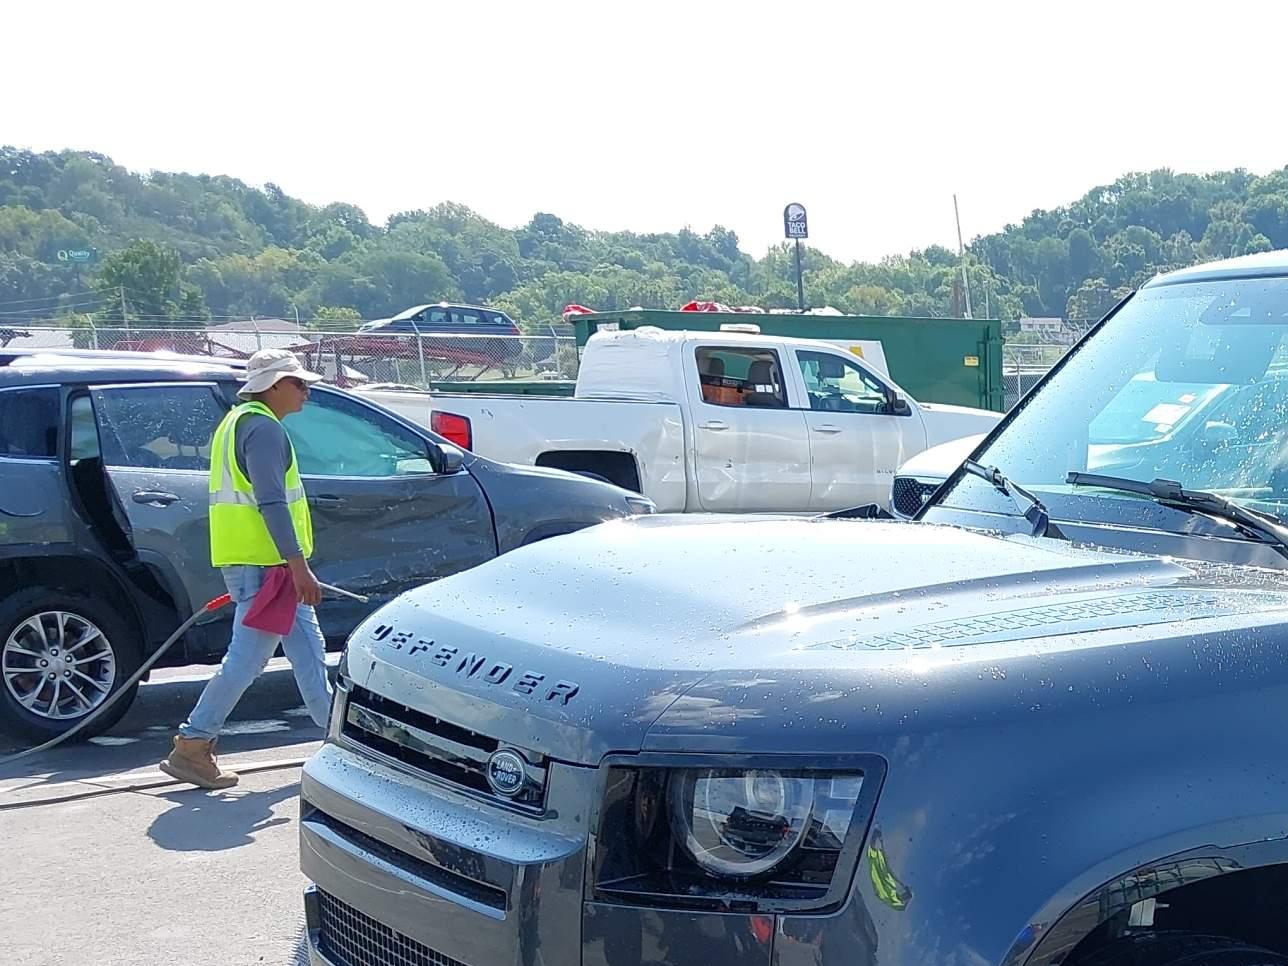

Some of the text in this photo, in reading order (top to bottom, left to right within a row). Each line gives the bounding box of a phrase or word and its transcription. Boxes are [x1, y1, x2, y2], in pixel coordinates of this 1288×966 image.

[370, 624, 580, 706] DEFENDER
[496, 760, 514, 773] LAND
[496, 770, 517, 785] ROVER
